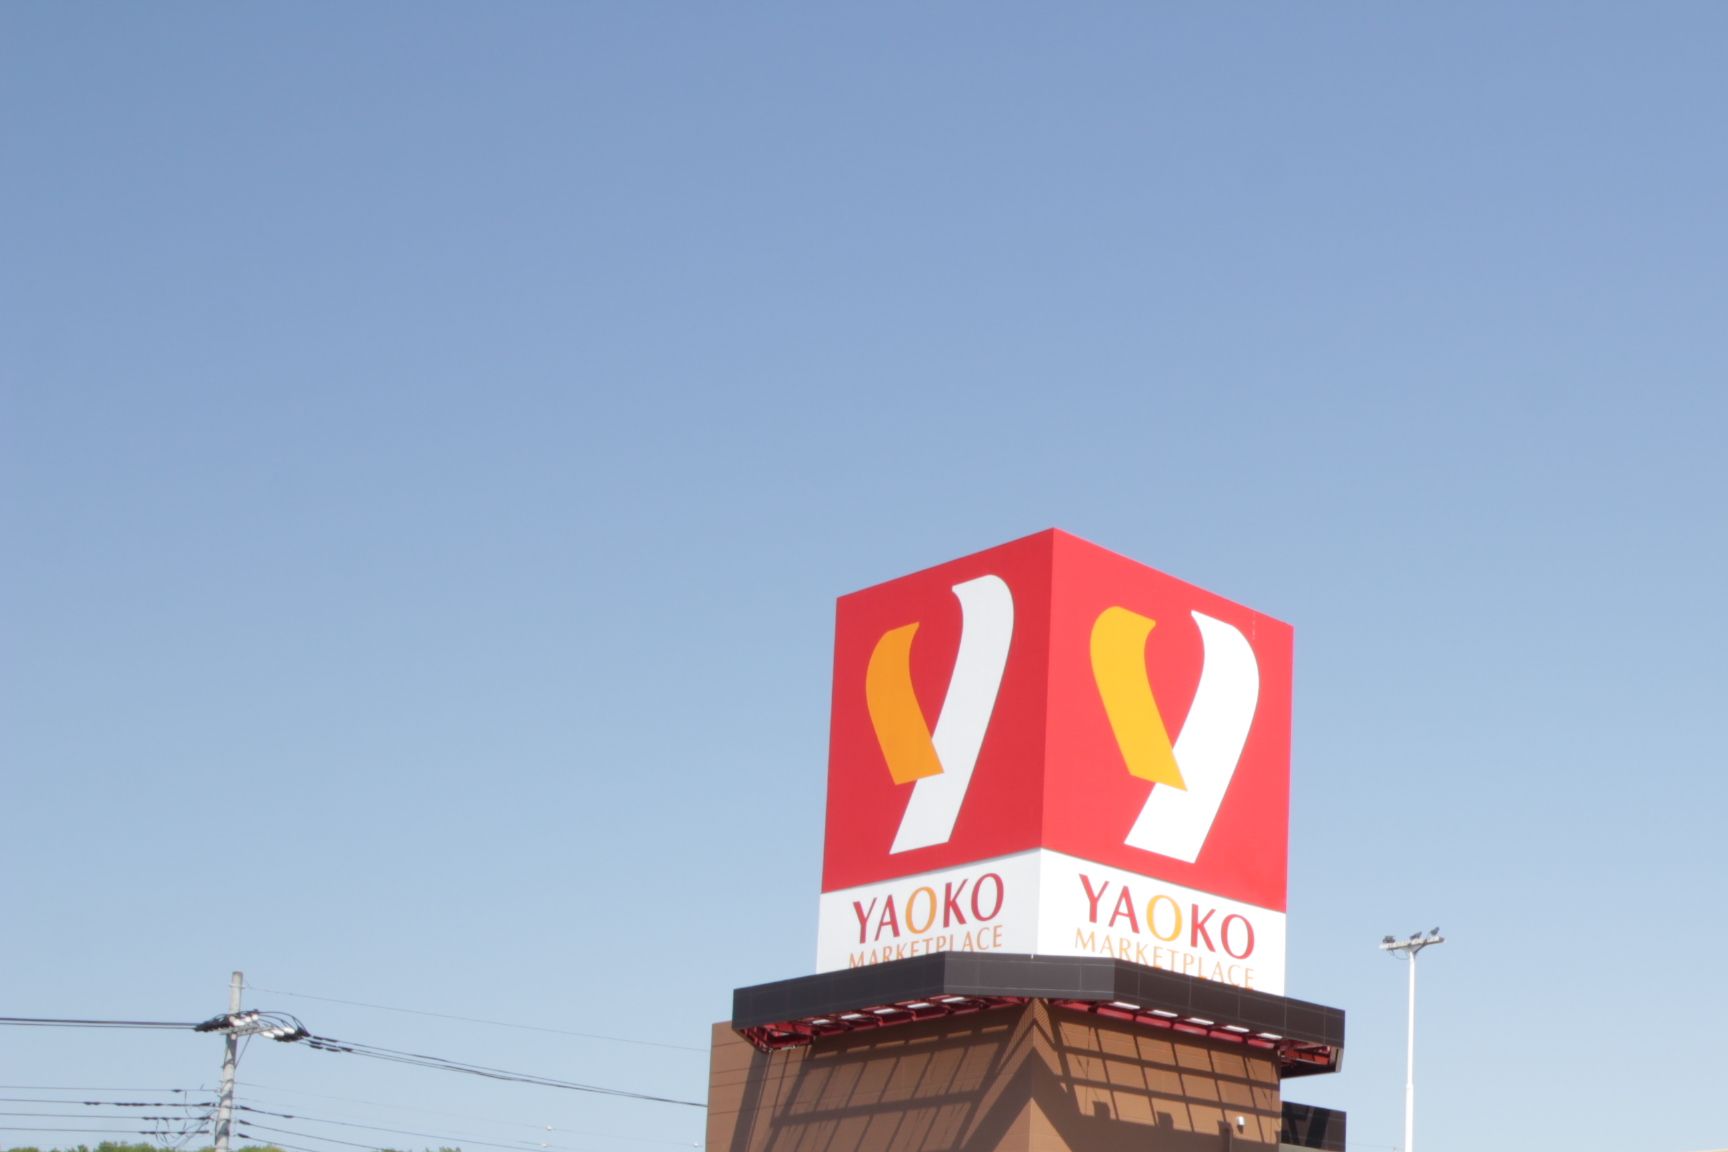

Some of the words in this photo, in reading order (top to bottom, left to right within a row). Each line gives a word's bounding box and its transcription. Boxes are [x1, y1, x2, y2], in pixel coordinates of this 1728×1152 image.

[852, 873, 1005, 944] YAOKO
[1079, 873, 1255, 959] YAOKO
[848, 925, 1004, 968] MARKETPLACE
[1075, 927, 1255, 990] MARKETPLACE
